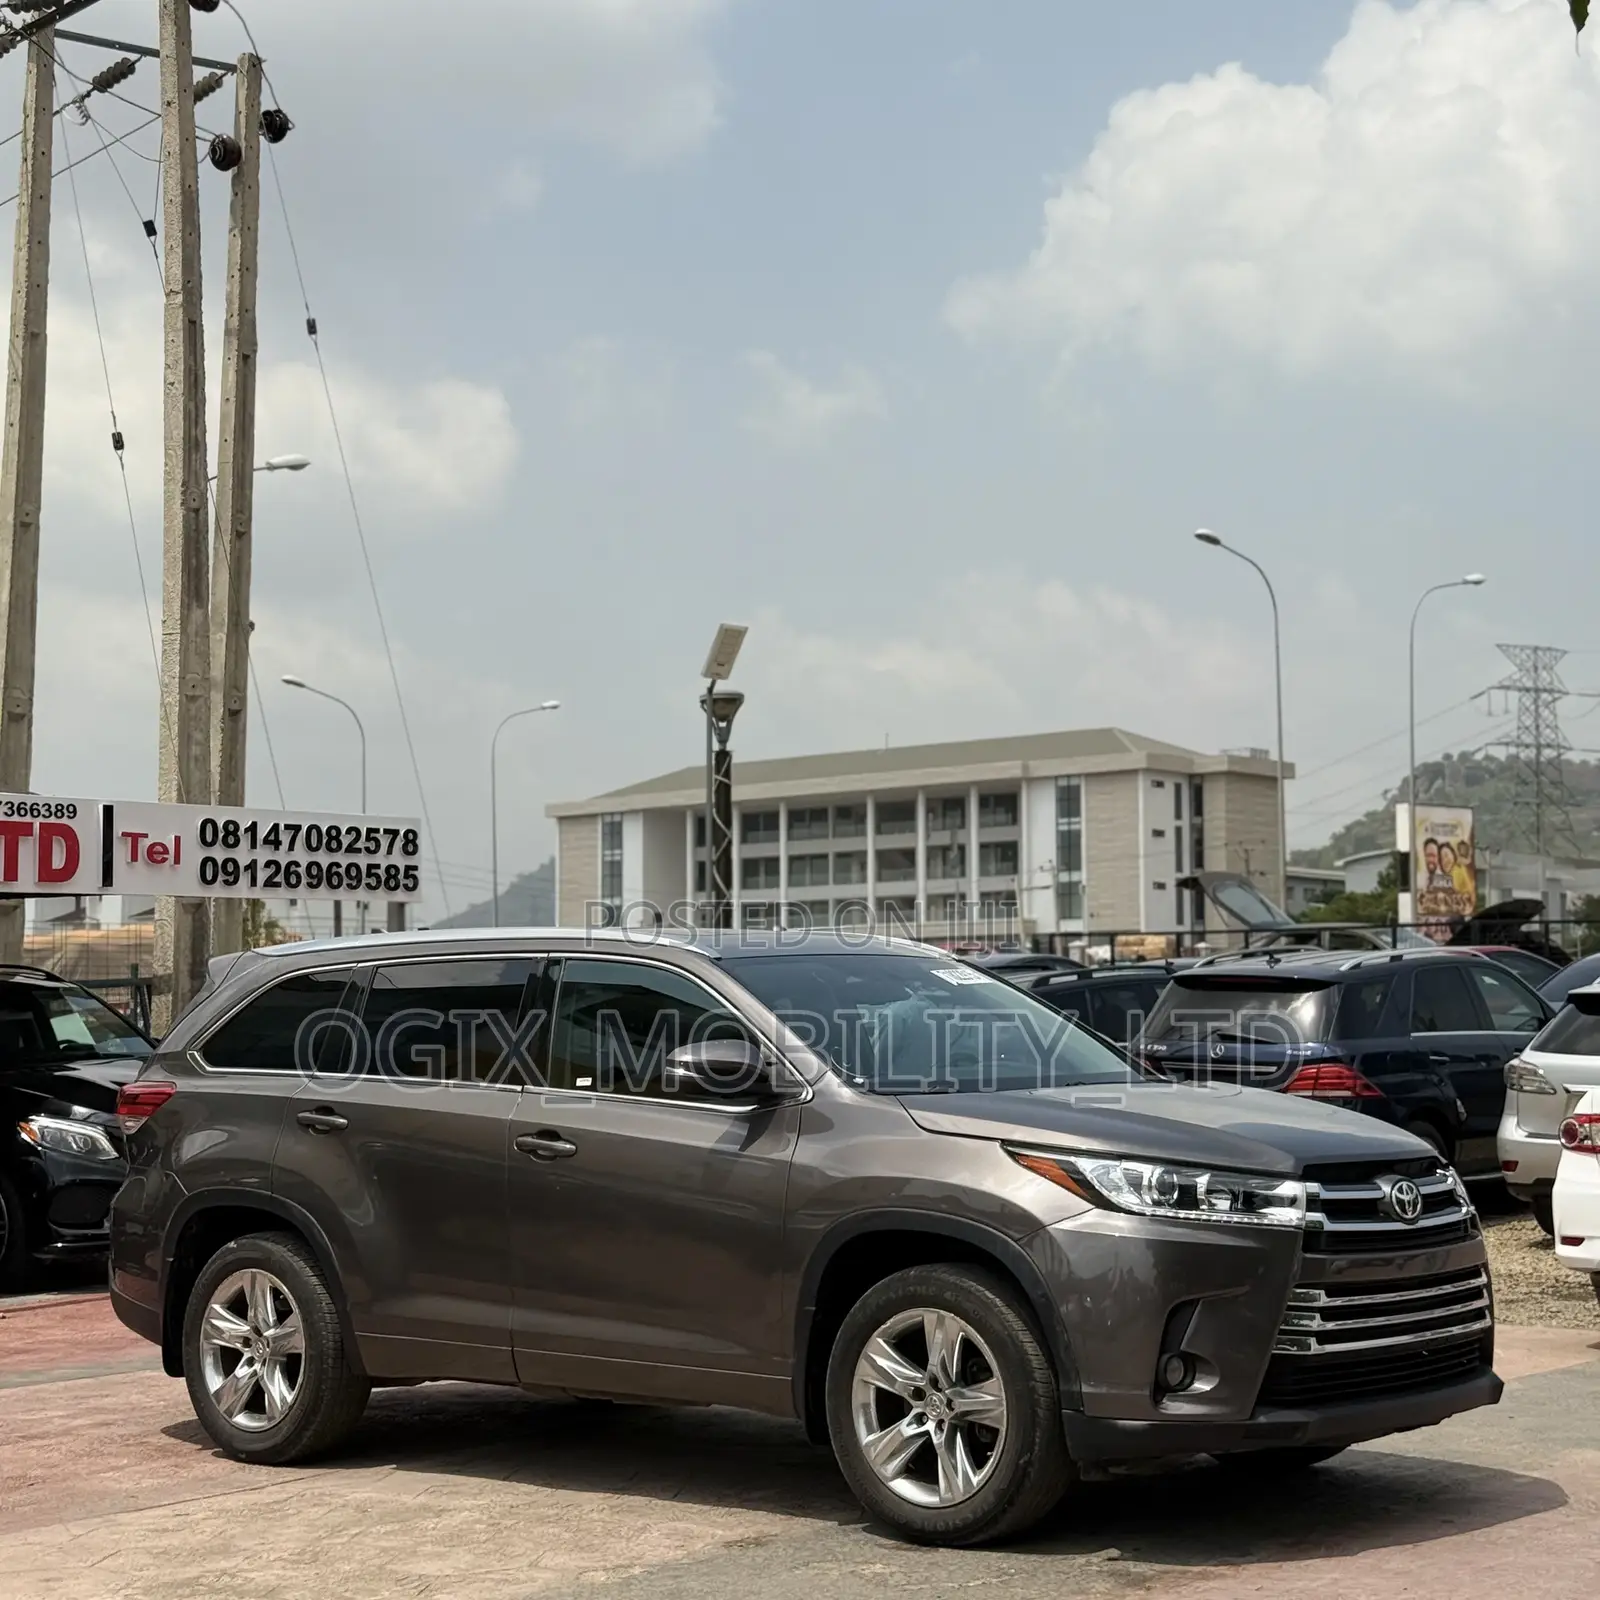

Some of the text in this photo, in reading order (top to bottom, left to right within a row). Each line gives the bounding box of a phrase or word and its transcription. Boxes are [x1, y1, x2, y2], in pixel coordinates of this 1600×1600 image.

[120, 831, 182, 866] Tel
[199, 817, 419, 856] 08147082578
[199, 855, 419, 892] 09126969585
